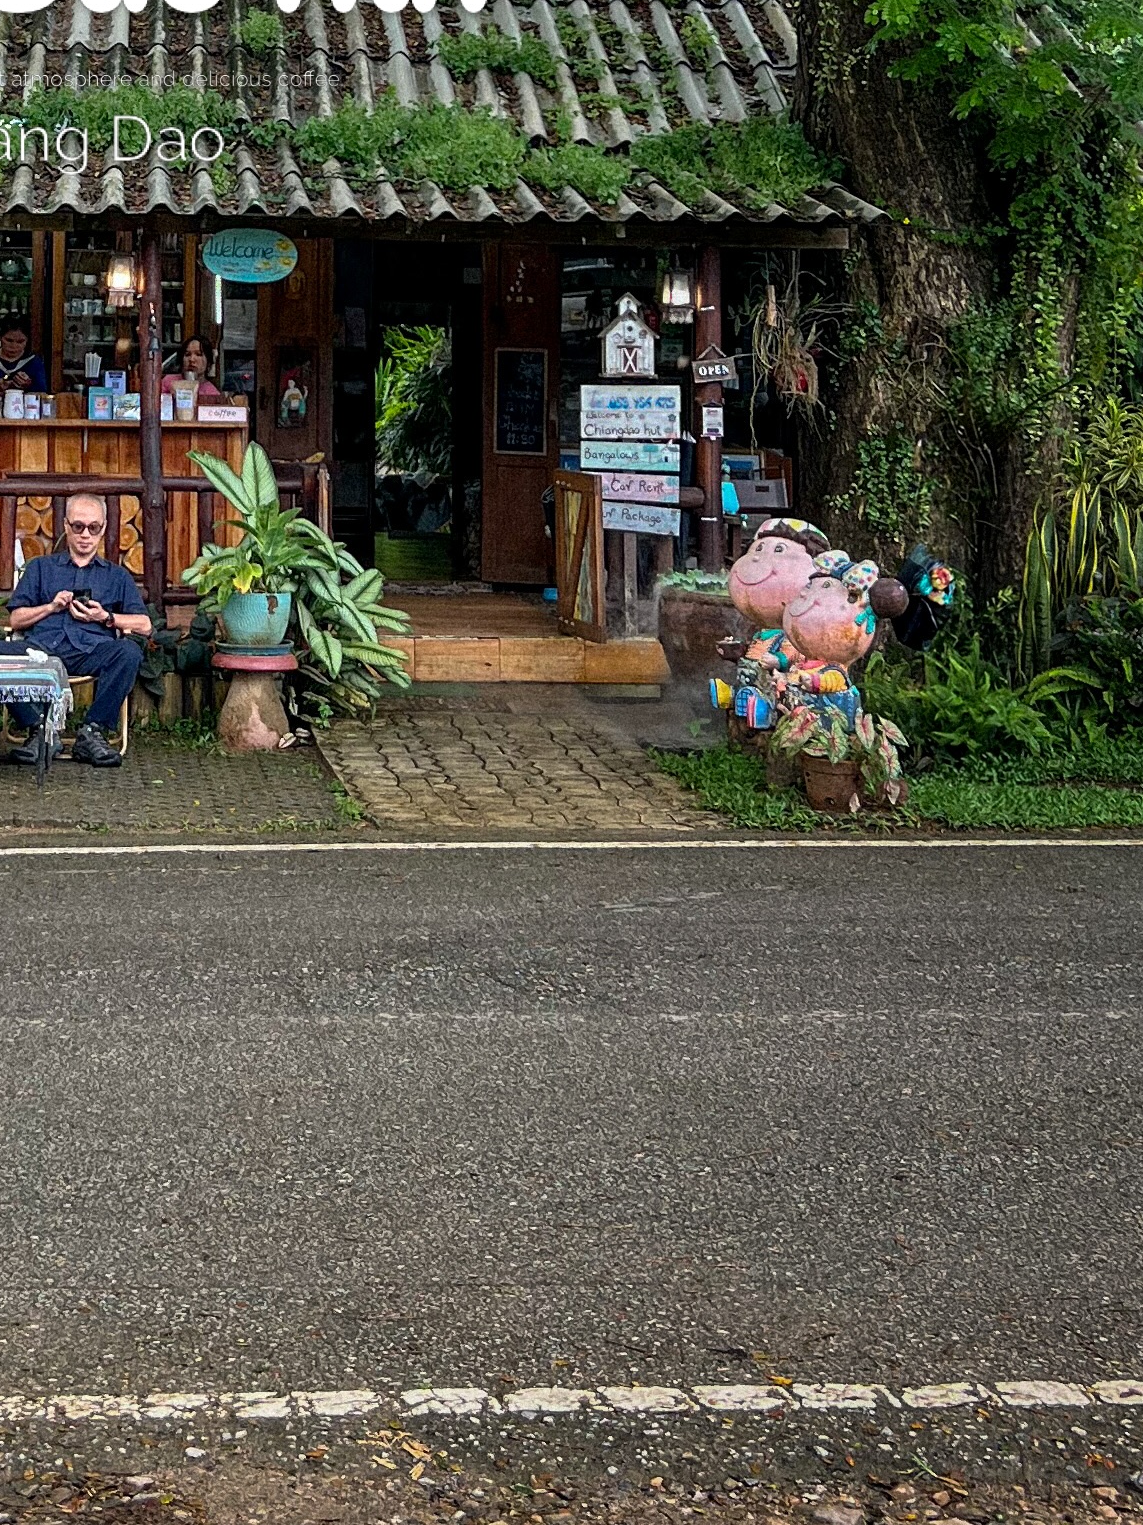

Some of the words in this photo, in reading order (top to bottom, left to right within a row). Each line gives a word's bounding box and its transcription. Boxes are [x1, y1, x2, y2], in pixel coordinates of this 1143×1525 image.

[206, 236, 276, 260] Welcome
[698, 364, 730, 376] OPEN
[610, 479, 635, 493] Car
[639, 479, 665, 494] Rent
[621, 507, 662, 527] Package
